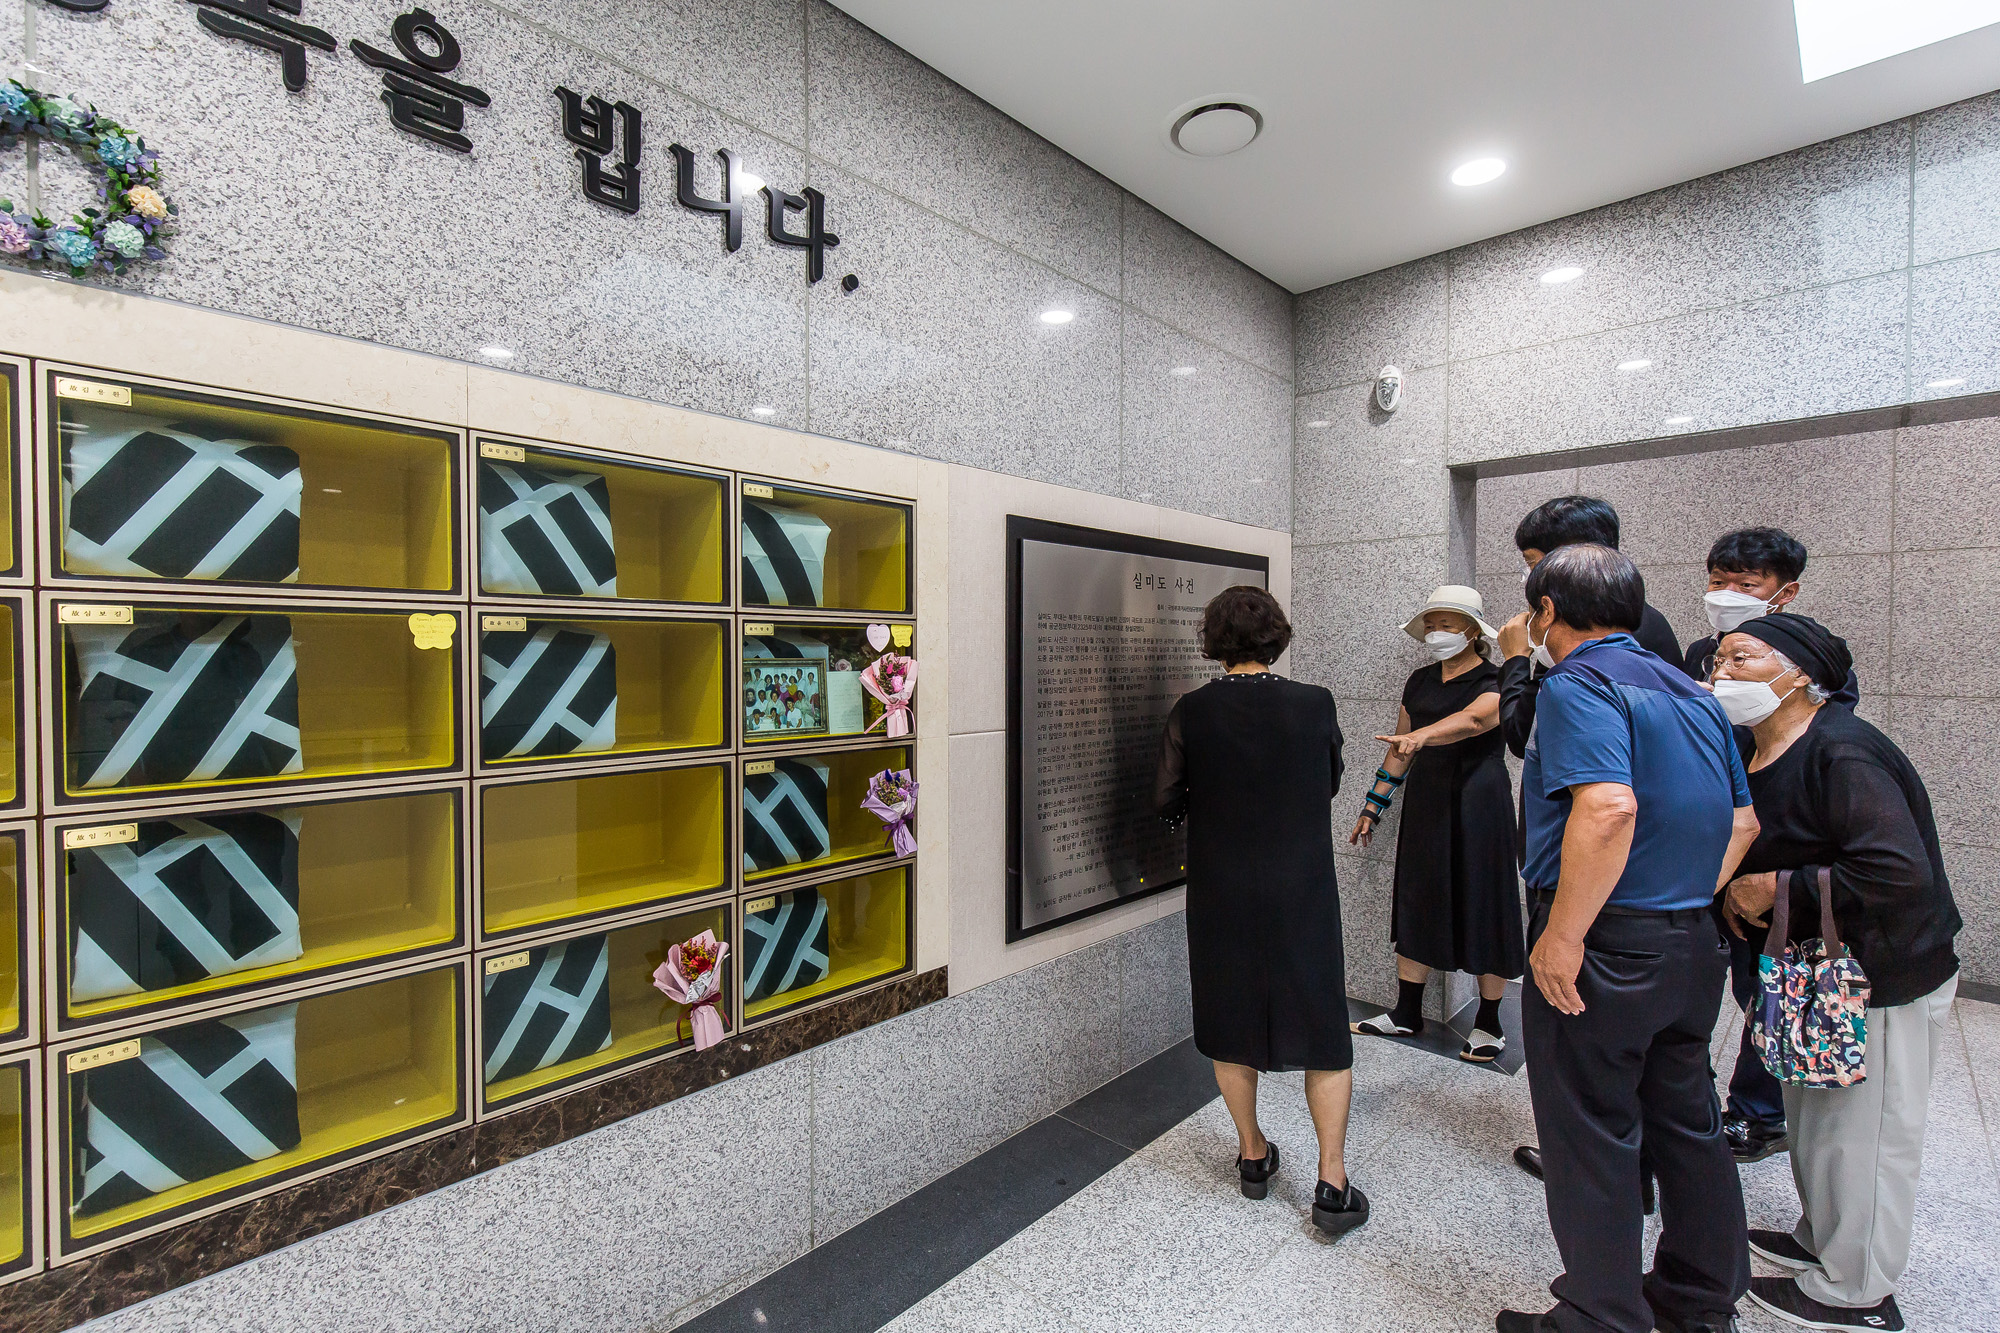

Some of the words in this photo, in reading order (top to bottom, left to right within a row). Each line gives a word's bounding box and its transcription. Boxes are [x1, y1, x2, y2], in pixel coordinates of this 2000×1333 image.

[554, 84, 859, 292] 빕니다.
[1132, 571, 1166, 591] 실미도
[1174, 576, 1194, 594] 사건
[1053, 635, 1068, 643] 사건은
[1037, 667, 1054, 675] 2004년
[1063, 667, 1077, 675] 실미도
